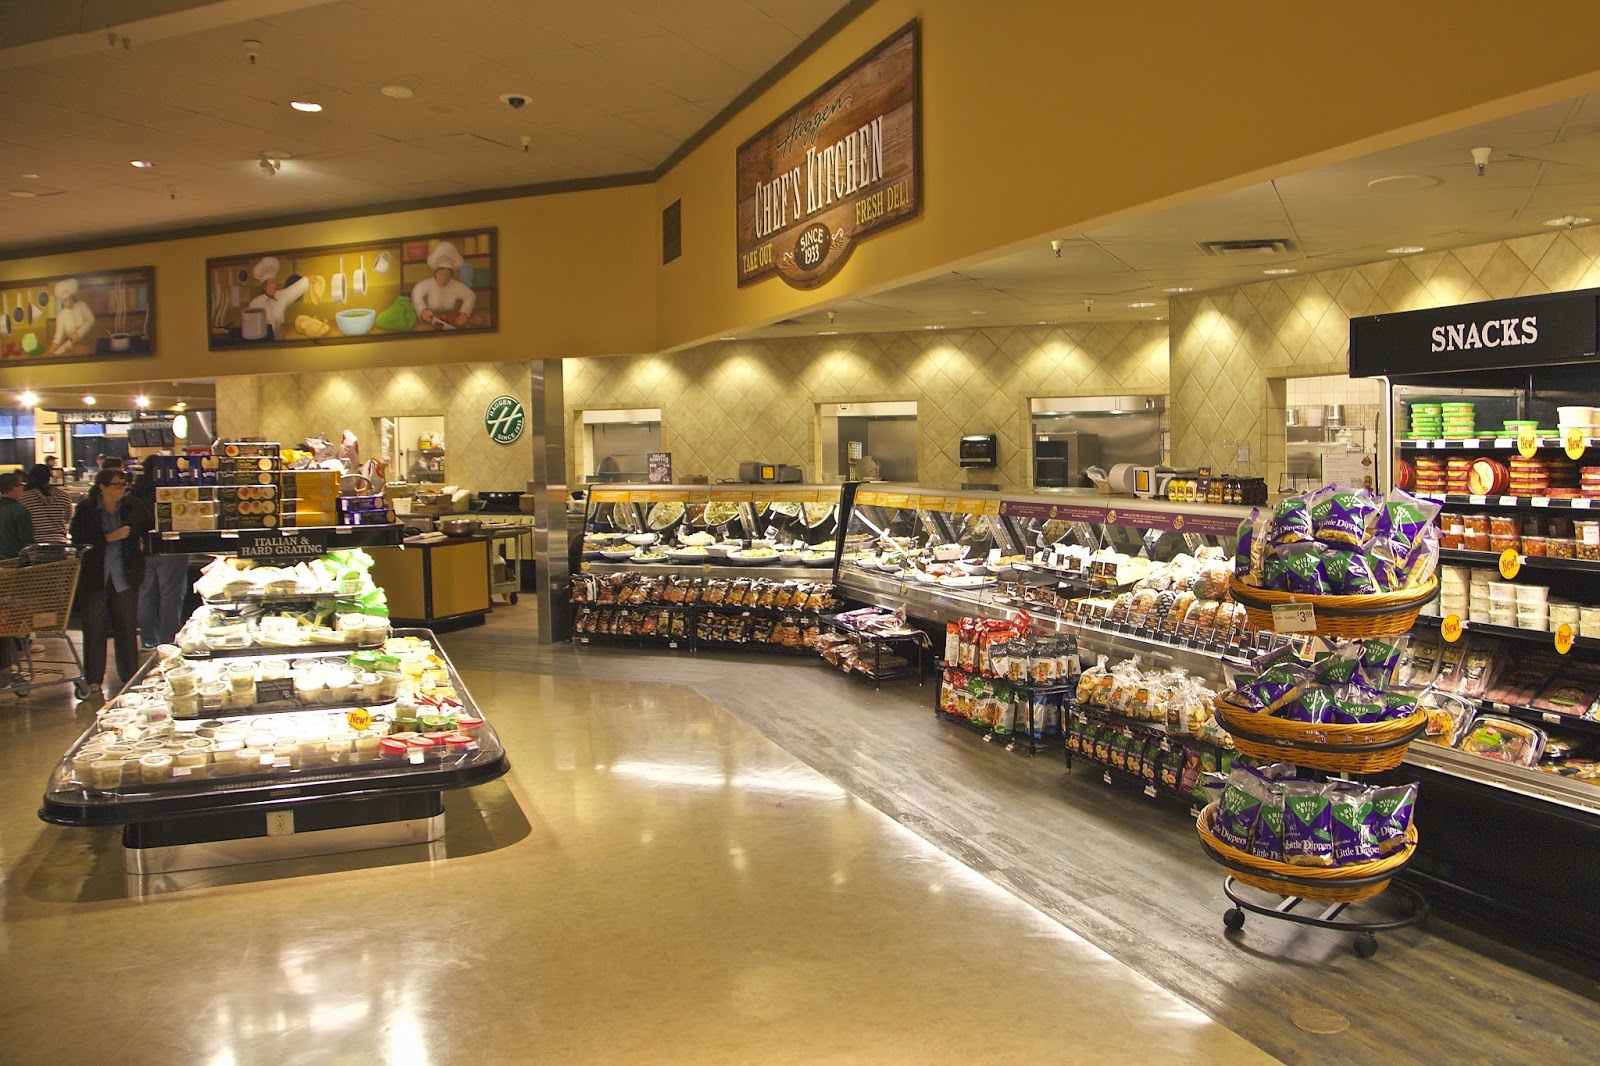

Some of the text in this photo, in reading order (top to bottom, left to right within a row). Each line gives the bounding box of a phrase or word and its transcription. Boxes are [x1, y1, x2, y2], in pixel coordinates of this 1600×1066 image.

[776, 95, 852, 160] Haggen
[755, 115, 883, 238] CHEF'S KITCHEN
[855, 179, 909, 226] FRESH DELI
[800, 228, 824, 251] SINCE
[742, 244, 773, 274] TAKE OUT
[805, 244, 820, 265] 1933
[1431, 316, 1538, 352] SNACKS
[58, 410, 138, 421] STARBUCKS COFFEE
[489, 399, 512, 417] HAGGEN
[1520, 436, 1535, 449] New!
[1568, 435, 1583, 450] New!
[254, 536, 310, 547] ITALIAN &
[242, 545, 323, 556] HARD GRATING
[1502, 555, 1518, 572] New!
[1444, 620, 1460, 636] New!
[350, 713, 368, 726] New!
[1221, 826, 1247, 845] Dippers
[1301, 839, 1332, 852] Dippers
[1335, 845, 1354, 858] Little
